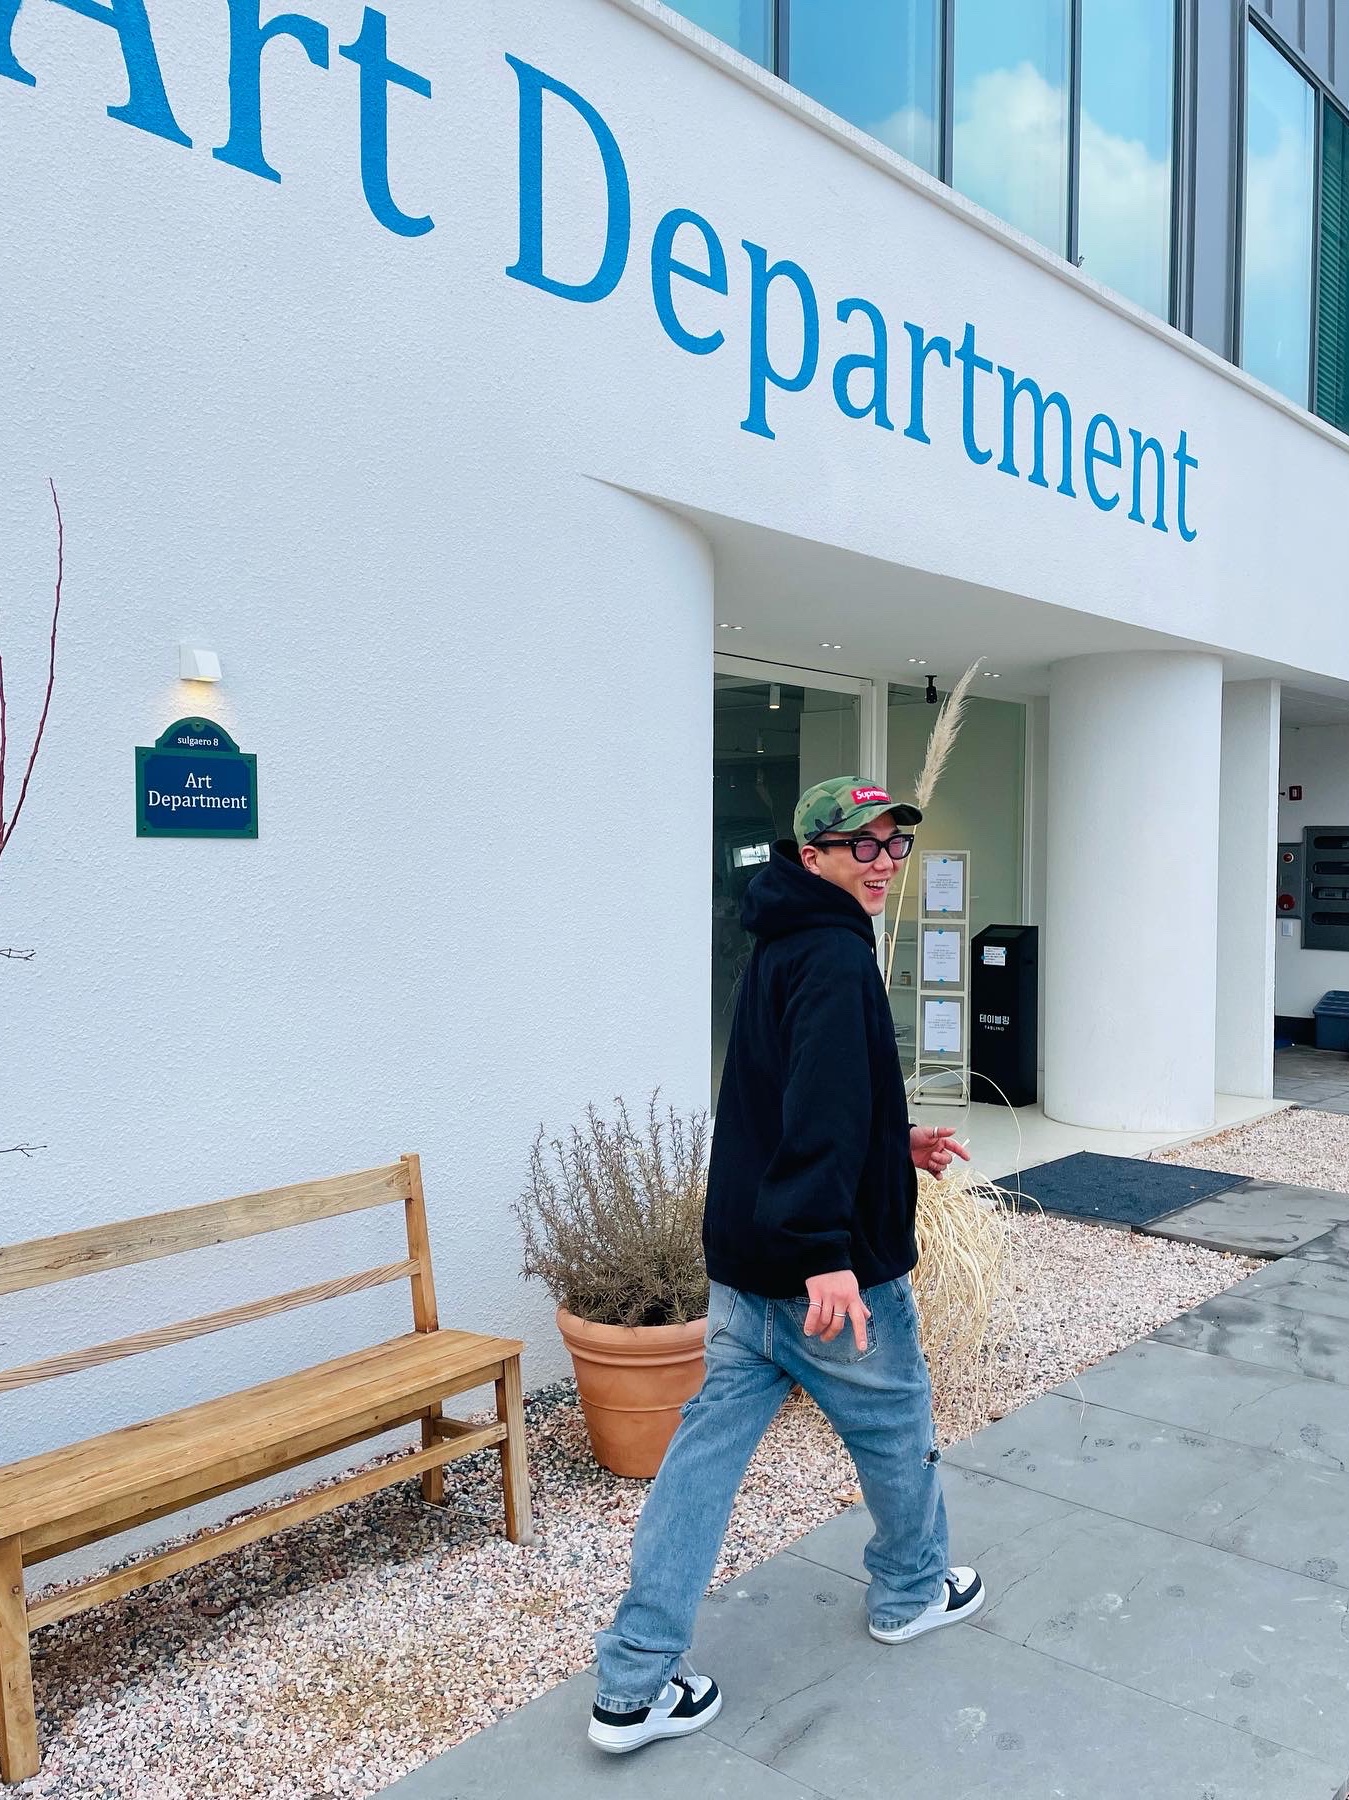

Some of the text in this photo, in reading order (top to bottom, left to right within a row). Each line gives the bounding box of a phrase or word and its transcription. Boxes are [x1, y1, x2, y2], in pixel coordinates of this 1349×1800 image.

[505, 52, 1198, 543] Department
[177, 736, 219, 747] sulgaero 8
[185, 772, 212, 789] Art
[148, 790, 248, 811] Department
[856, 790, 887, 800] Suprem
